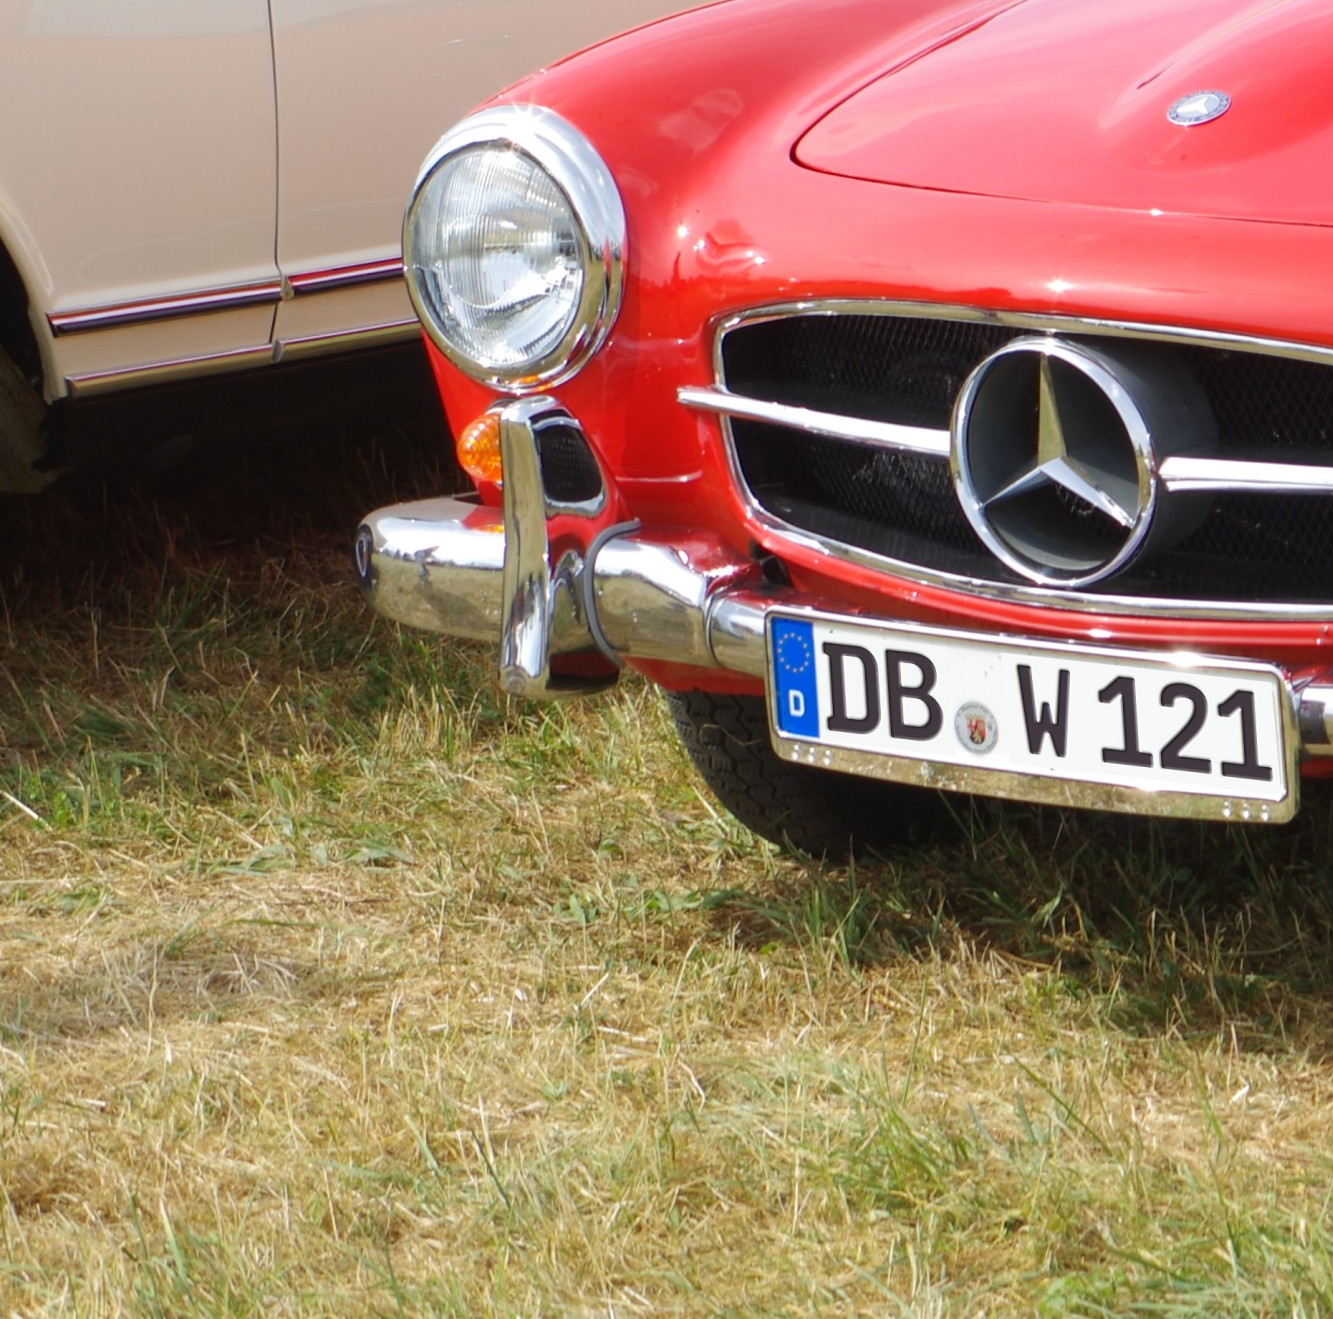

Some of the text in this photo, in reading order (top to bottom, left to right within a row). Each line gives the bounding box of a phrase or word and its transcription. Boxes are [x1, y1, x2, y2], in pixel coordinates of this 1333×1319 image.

[789, 689, 806, 718] D
[823, 641, 945, 742] DB
[1017, 663, 1072, 759] W
[1098, 674, 1275, 783] 121
